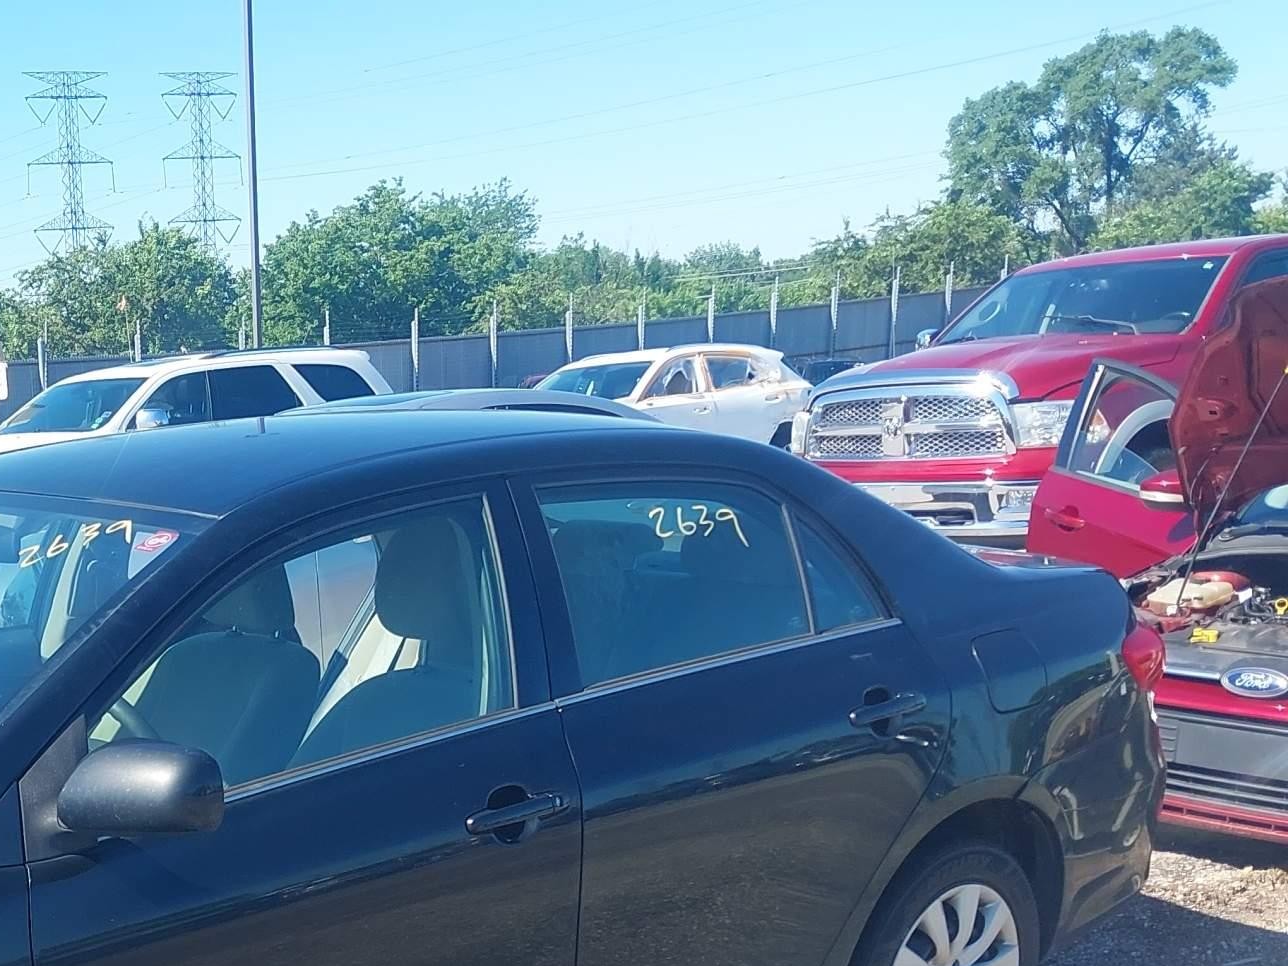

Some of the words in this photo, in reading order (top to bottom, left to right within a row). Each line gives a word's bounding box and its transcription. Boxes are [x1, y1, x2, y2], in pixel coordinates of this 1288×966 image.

[17, 519, 133, 569] 2639
[648, 504, 750, 548] 2639
[1234, 671, 1272, 690] Ford
